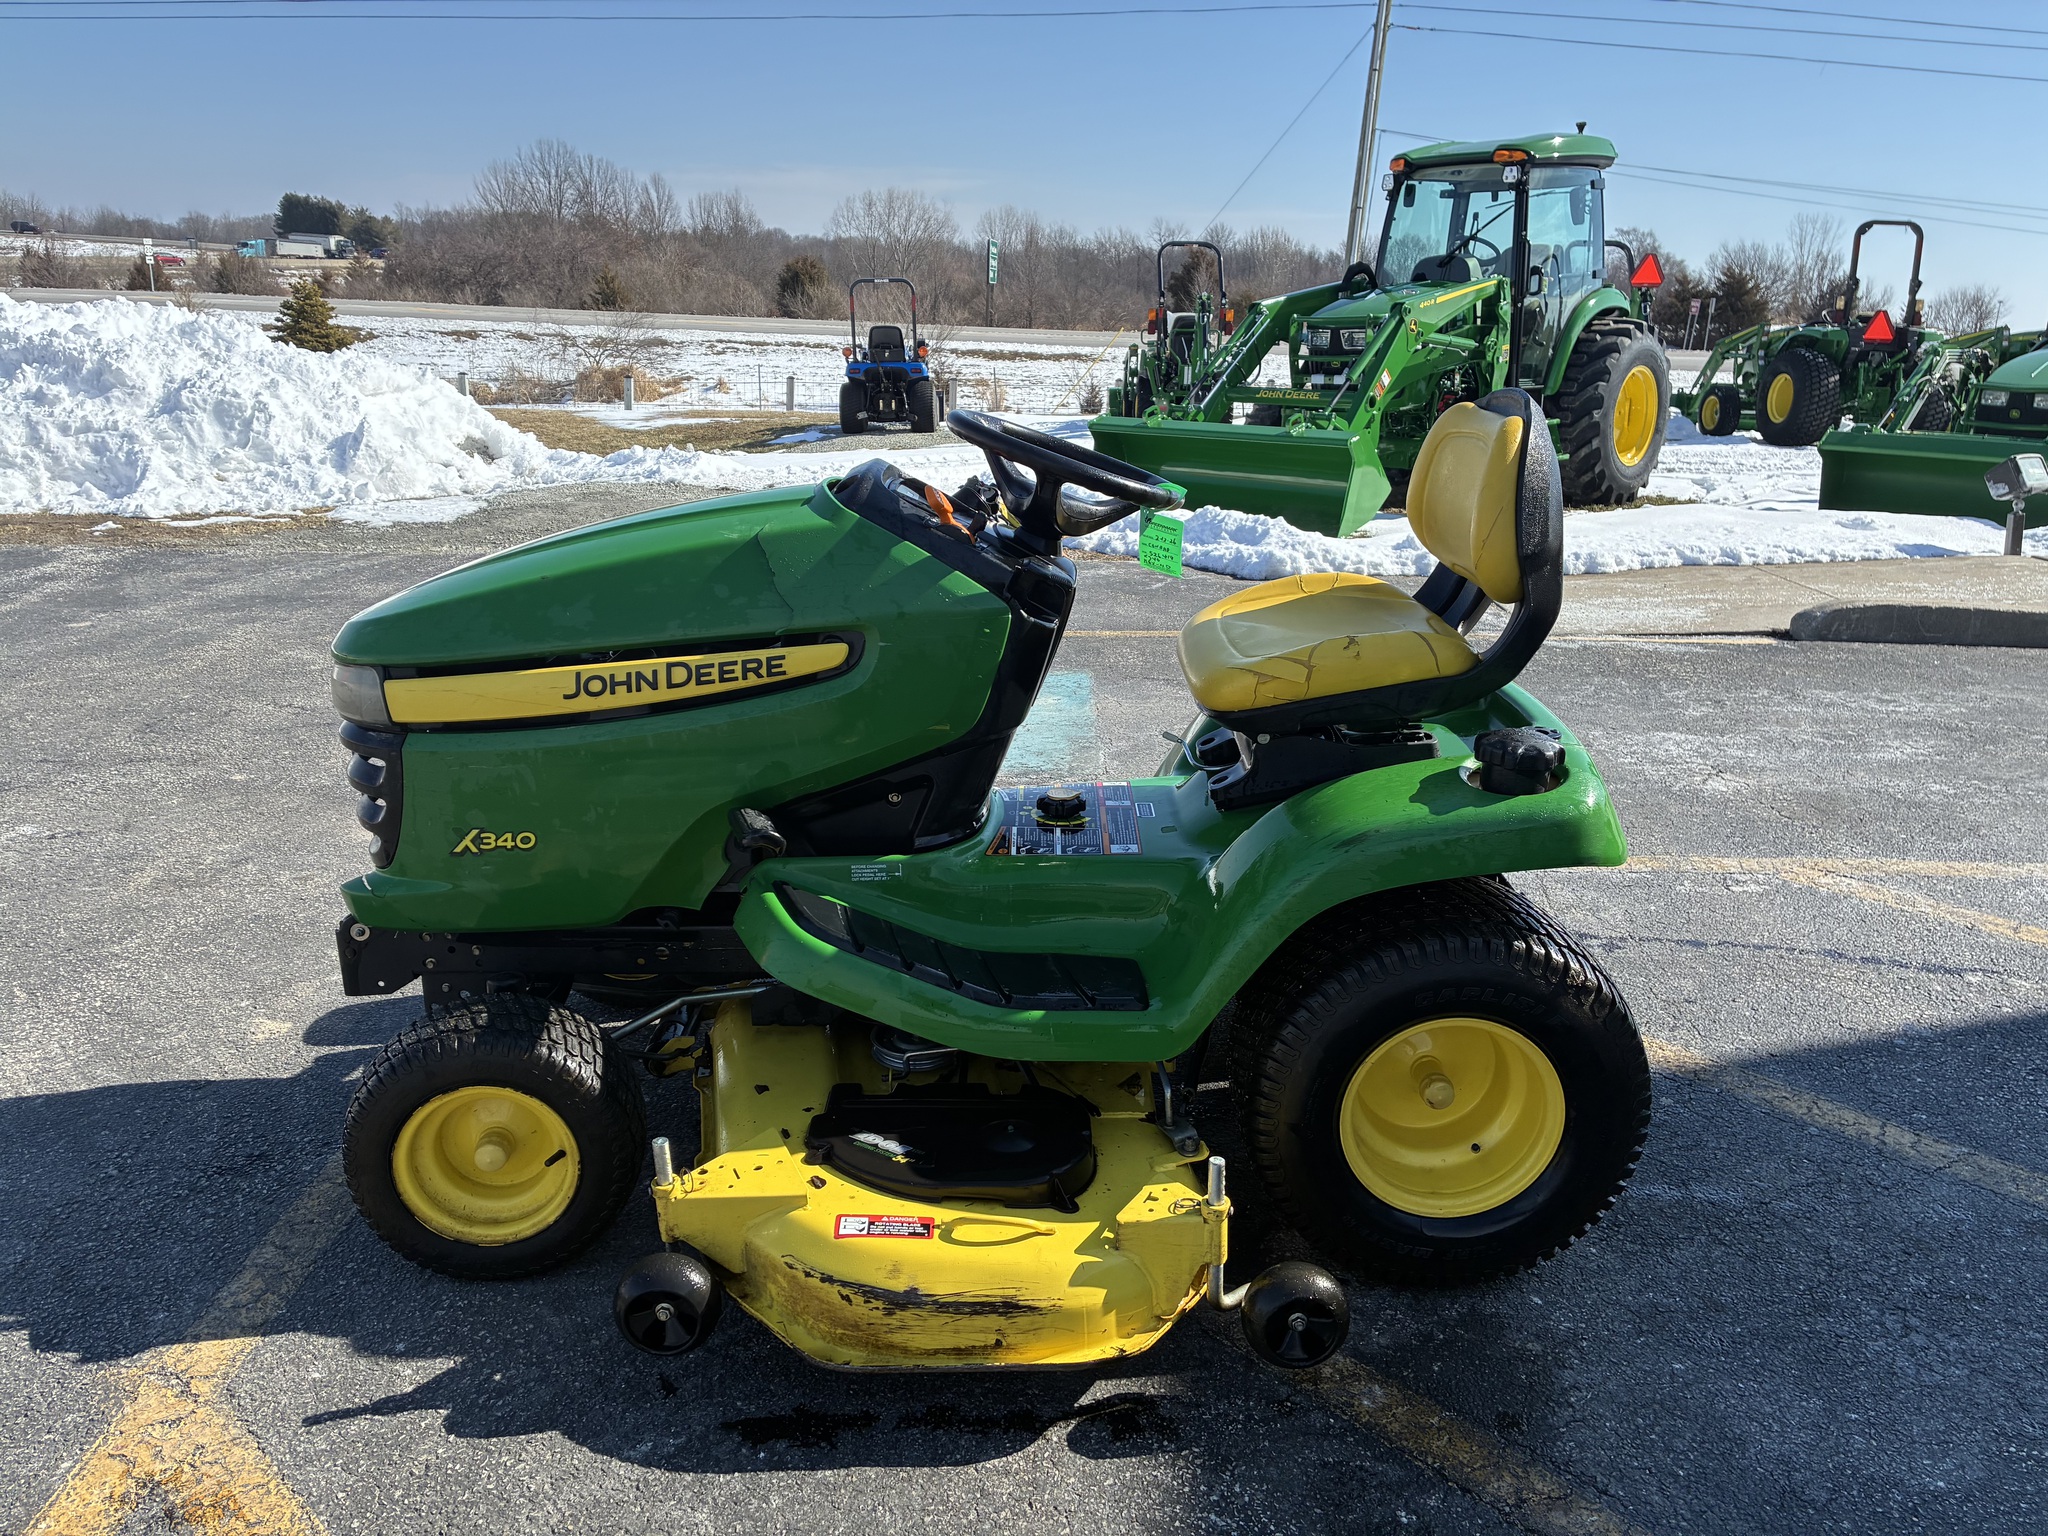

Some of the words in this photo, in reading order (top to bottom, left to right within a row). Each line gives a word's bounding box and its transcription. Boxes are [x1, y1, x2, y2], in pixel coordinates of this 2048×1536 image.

[1419, 298, 1435, 308] 440R
[1256, 390, 1283, 398] JOHN
[1285, 390, 1320, 399] DEERE
[562, 668, 658, 700] JOHN
[666, 654, 787, 689] DEERE
[451, 828, 536, 854] X340
